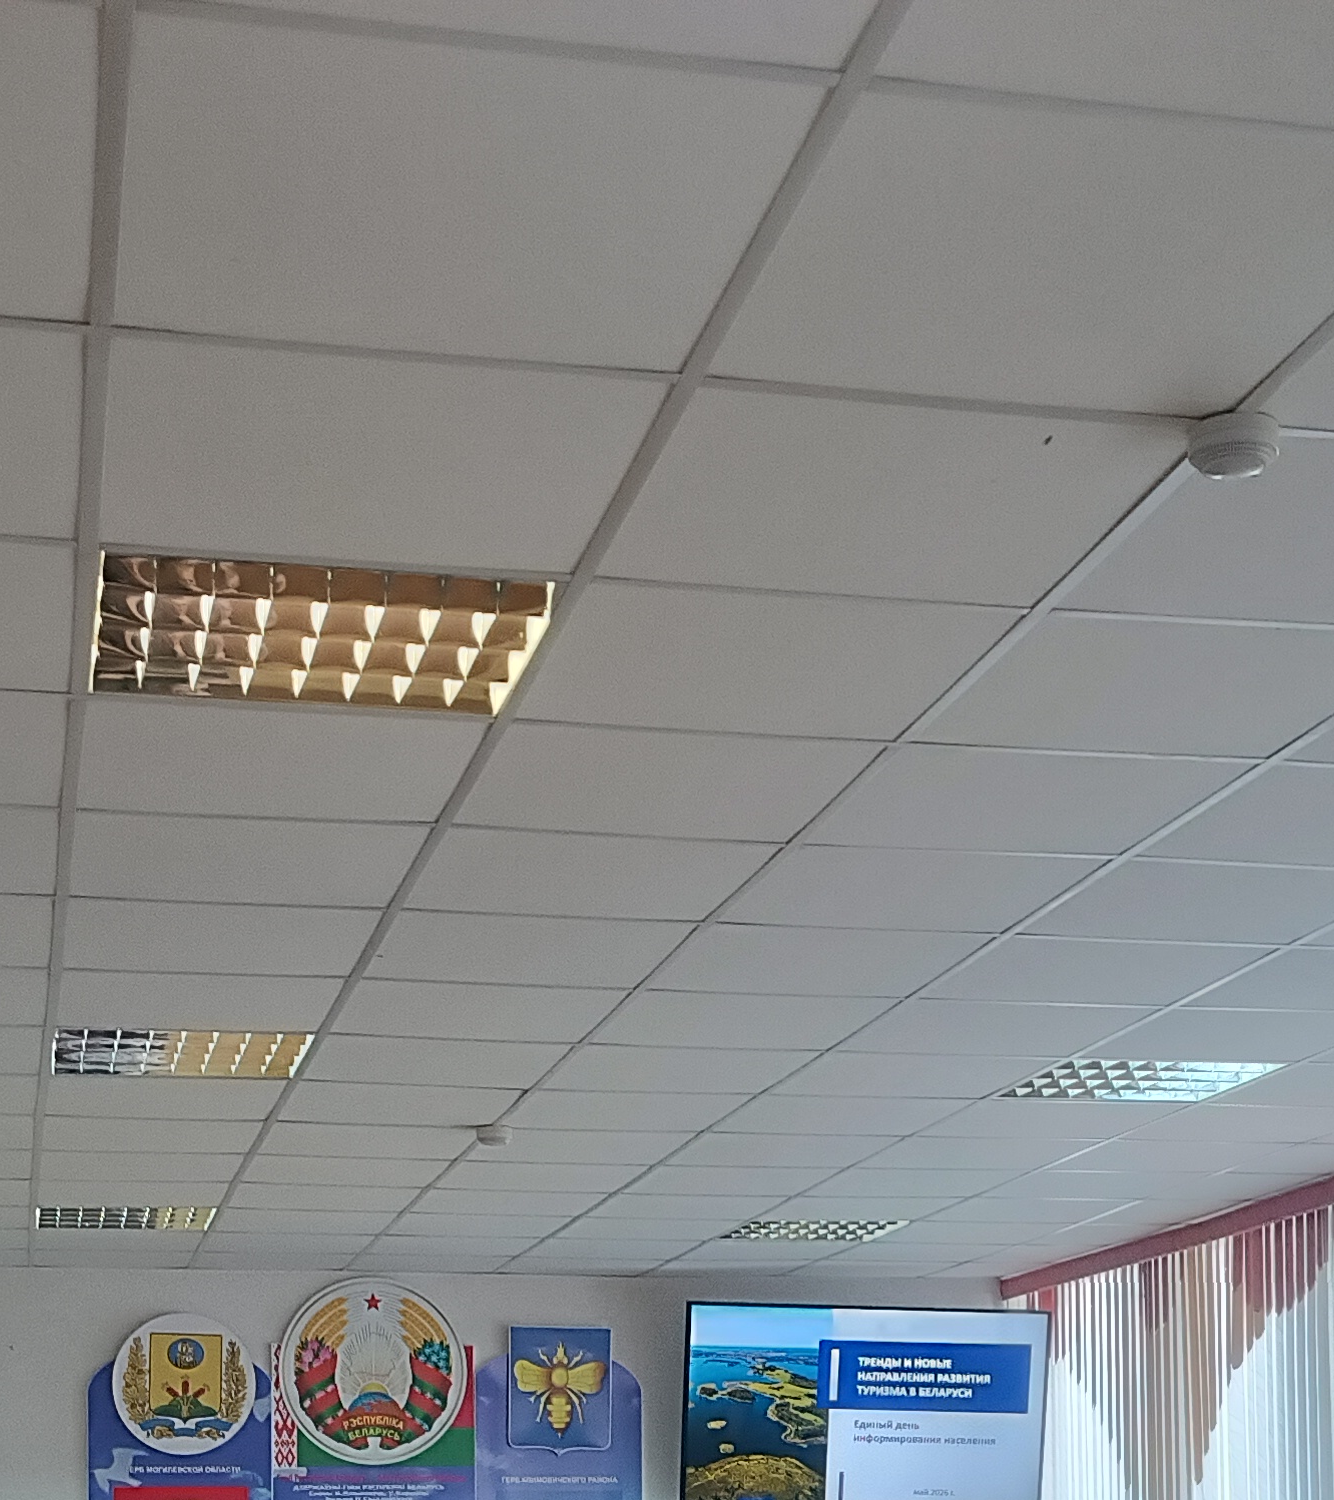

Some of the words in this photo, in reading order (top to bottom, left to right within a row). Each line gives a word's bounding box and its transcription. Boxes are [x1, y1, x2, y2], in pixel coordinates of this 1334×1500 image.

[857, 1356, 901, 1369] ТРЕНДЫ
[903, 1358, 912, 1369] И
[914, 1358, 953, 1370] НОВЫЕ
[857, 1371, 935, 1383] НАПРАВЛЕНИЯ
[937, 1373, 991, 1385] РАЗВИТИЯ
[856, 1385, 908, 1397] ТУРИЗМА
[909, 1386, 916, 1396] В
[919, 1387, 973, 1398] БЕЛАРУСИ
[342, 1415, 404, 1431] РЭСПУБЛІКА
[854, 1419, 893, 1430] Единый
[895, 1422, 920, 1432] день
[348, 1426, 401, 1440] БЕЛАРУСЬ
[854, 1433, 942, 1446] информирования
[944, 1436, 996, 1446] населения
[205, 1465, 241, 1474] ОБЛАСТИ
